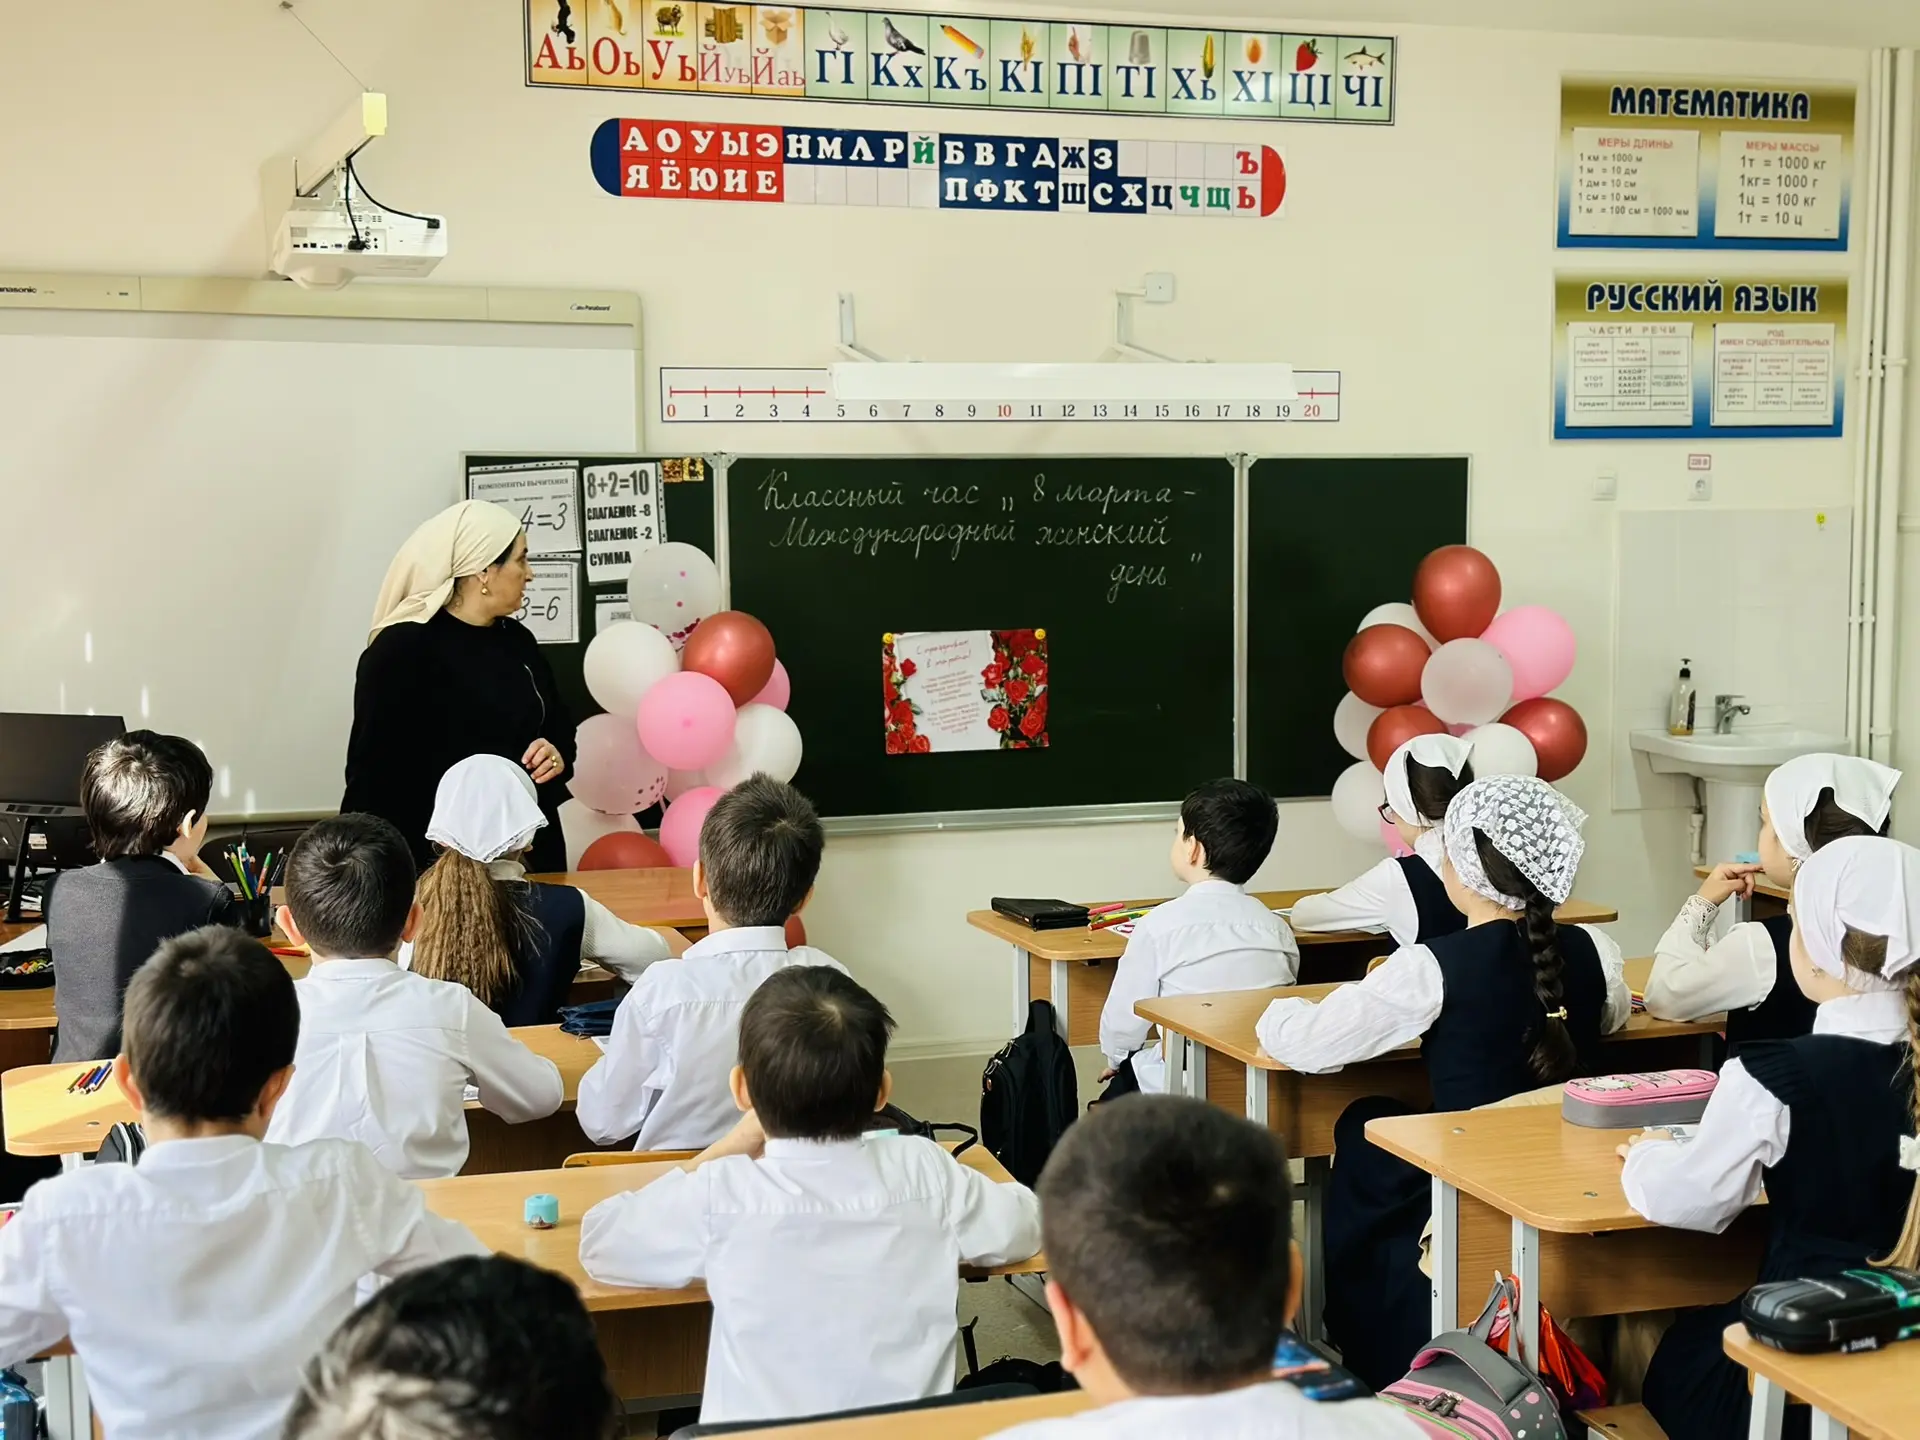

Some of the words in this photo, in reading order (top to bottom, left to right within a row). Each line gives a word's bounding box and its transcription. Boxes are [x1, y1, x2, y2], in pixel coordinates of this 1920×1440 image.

[1611, 87, 1809, 119] МАТЕМАТИКА
[1598, 138, 1630, 147] МЕРЫ
[1633, 139, 1673, 149] ДЛИНЫ
[1746, 141, 1777, 150] МЕРЫ
[1781, 142, 1819, 152] МАССЫ
[1612, 154, 1632, 162] 1000
[1778, 156, 1809, 169] 1000
[1777, 174, 1808, 188] 1000
[1776, 193, 1799, 206] 100
[1775, 212, 1789, 224] 10
[1587, 279, 1722, 312] РУССКИЙ
[1734, 286, 1818, 313] ЯЗЫК
[1589, 326, 1632, 335] ЧАСТИ
[1642, 326, 1676, 334] РЕЧИ
[667, 404, 676, 417] 0
[703, 404, 709, 417] 1
[735, 404, 744, 417] 2
[769, 404, 778, 417] 3
[802, 404, 811, 417] 4
[837, 404, 845, 417] 5
[869, 404, 878, 417] 6
[902, 404, 911, 417] 7
[935, 404, 944, 417] 8
[967, 404, 976, 417] 9
[998, 405, 1011, 417] 10
[1030, 405, 1043, 417] 11
[1061, 405, 1076, 417] 12
[1092, 405, 1108, 417] 13
[1123, 405, 1138, 417] 14
[1155, 405, 1169, 417] 15
[1185, 405, 1200, 417] 16
[1216, 405, 1231, 417] 17
[1246, 405, 1261, 417] 18
[1276, 405, 1291, 417] 19
[1303, 405, 1321, 417] 20
[758, 468, 904, 511] Классный
[923, 482, 980, 505] час
[1056, 484, 1174, 514] марта
[587, 505, 637, 520] СЛАГАЕМОЕ
[588, 527, 638, 542] СЛАГАЕМОЕ
[769, 516, 1017, 560] Международный
[1035, 516, 1172, 546] женский
[589, 551, 632, 566] СУММА
